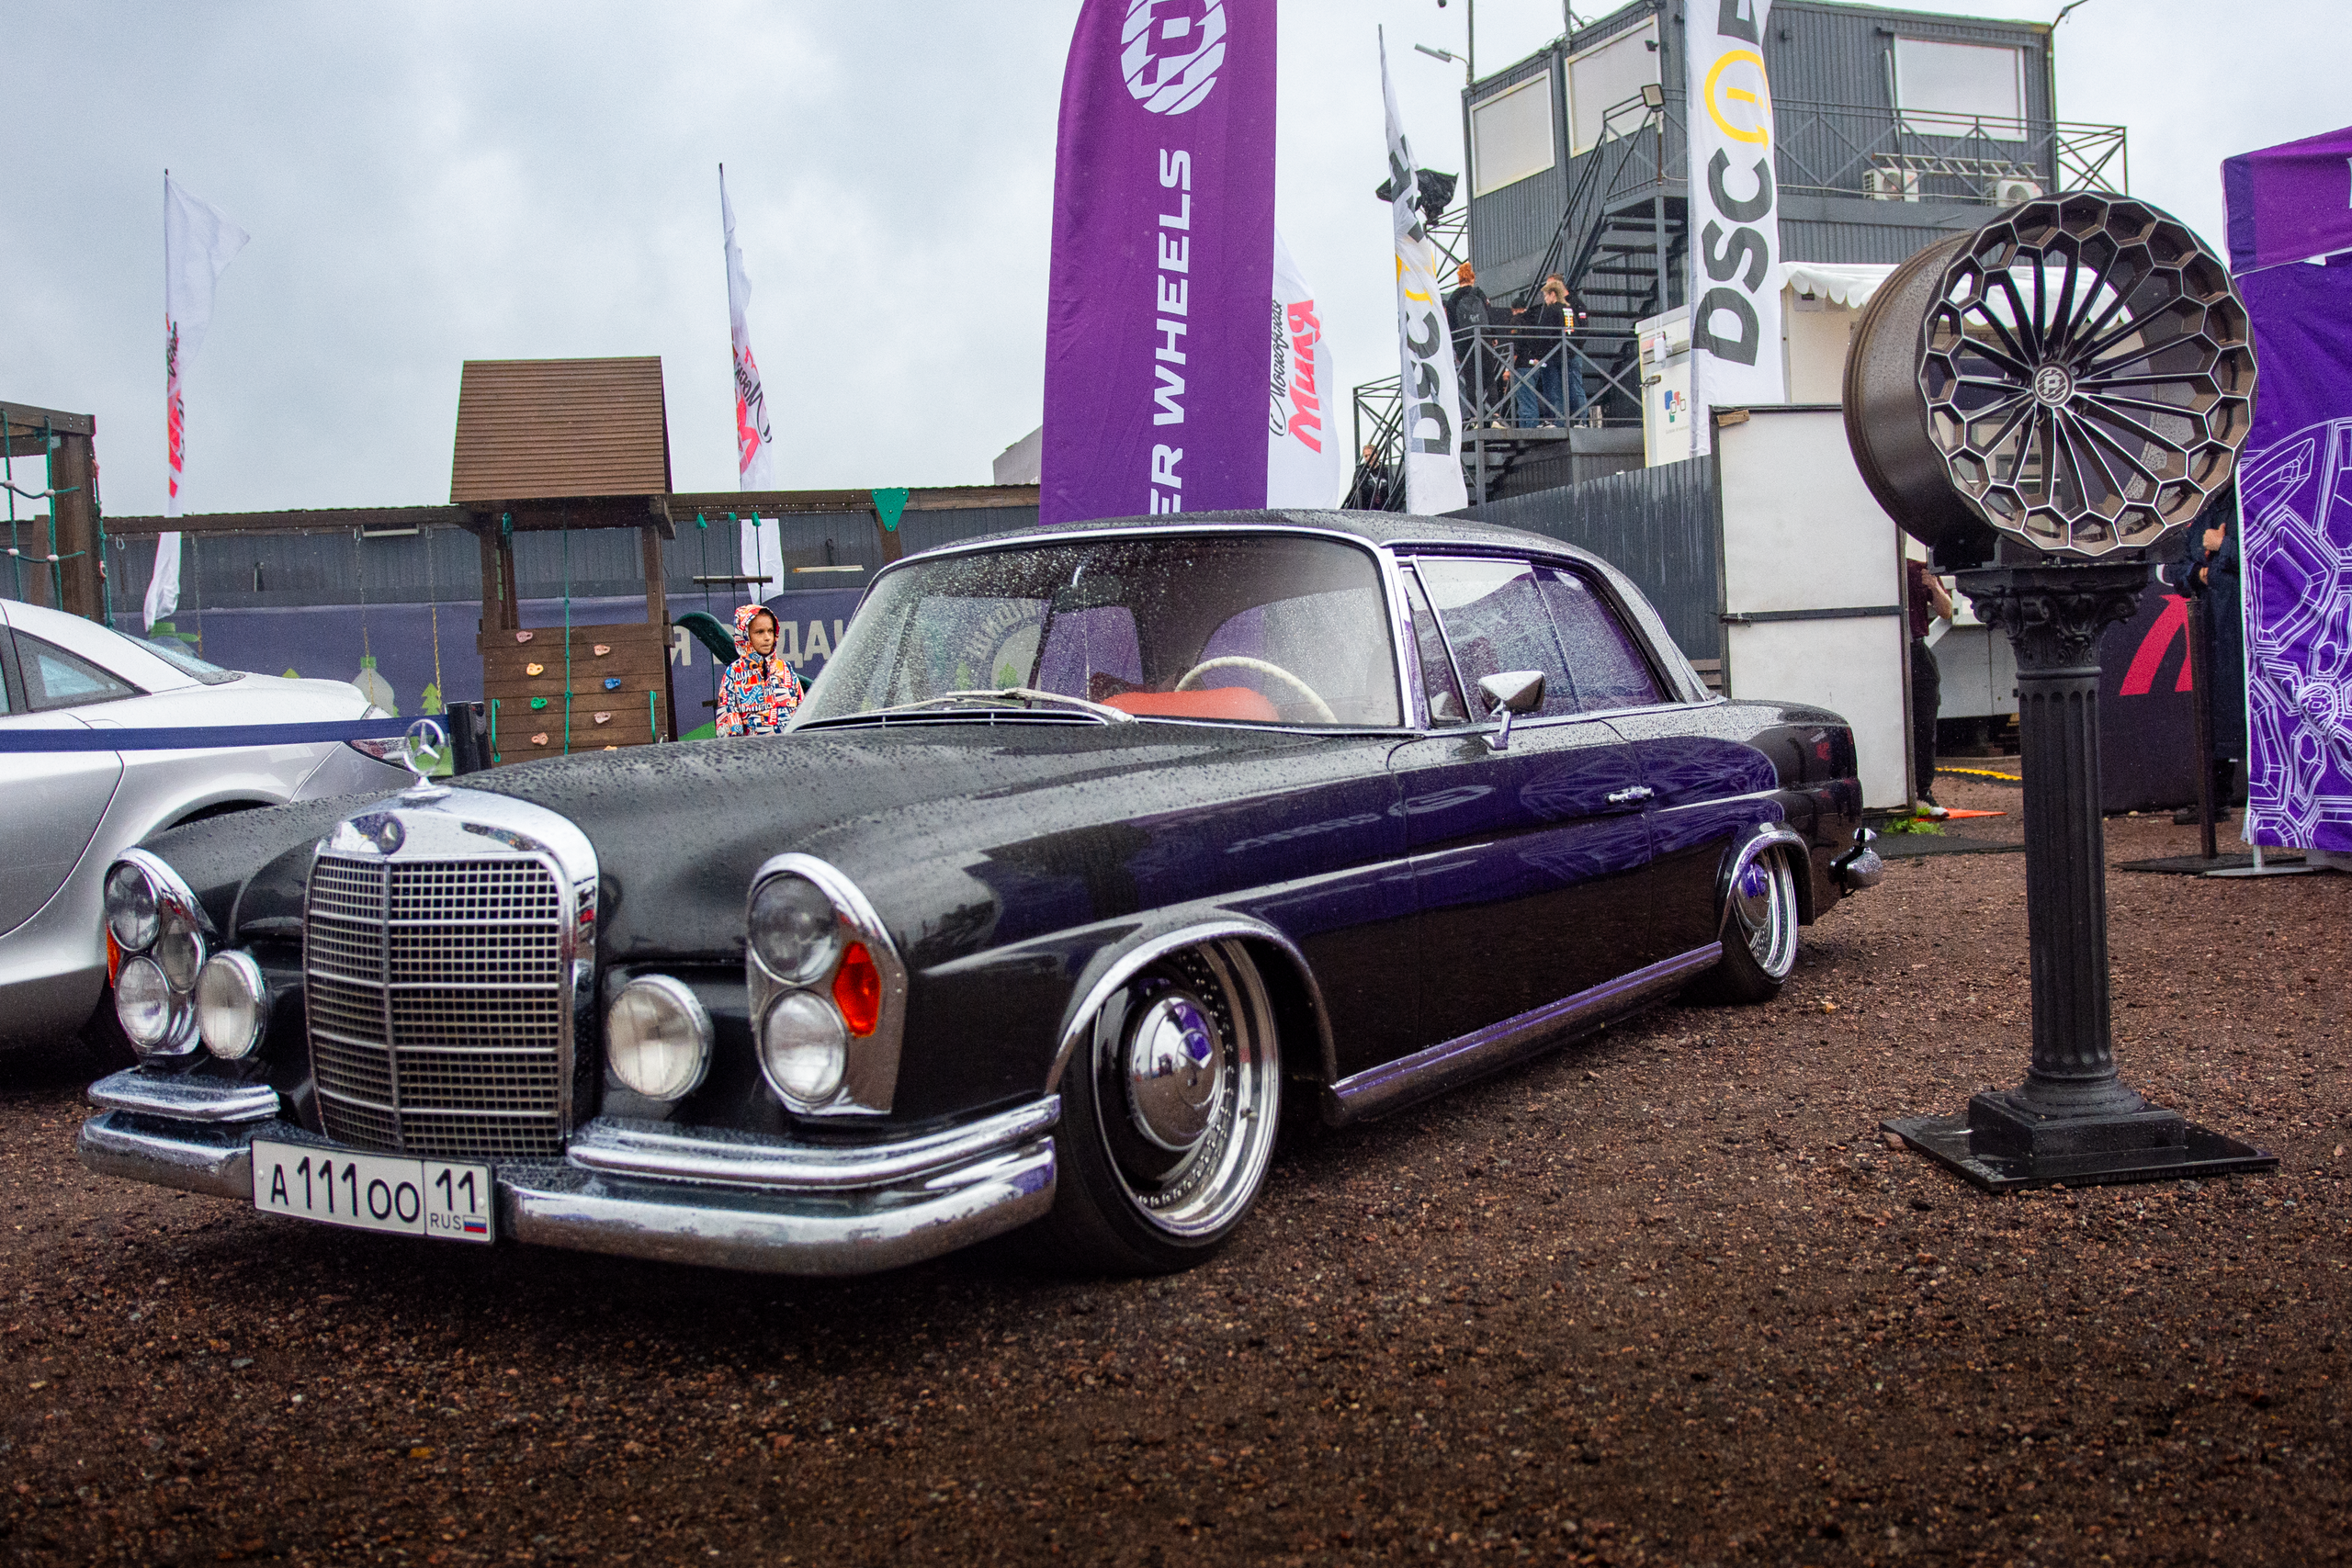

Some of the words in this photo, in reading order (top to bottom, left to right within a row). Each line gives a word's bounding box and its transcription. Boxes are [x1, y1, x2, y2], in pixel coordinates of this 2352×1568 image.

[1153, 148, 1192, 426] WHEELS
[435, 1168, 476, 1213] 11
[429, 1212, 462, 1231] RUS
